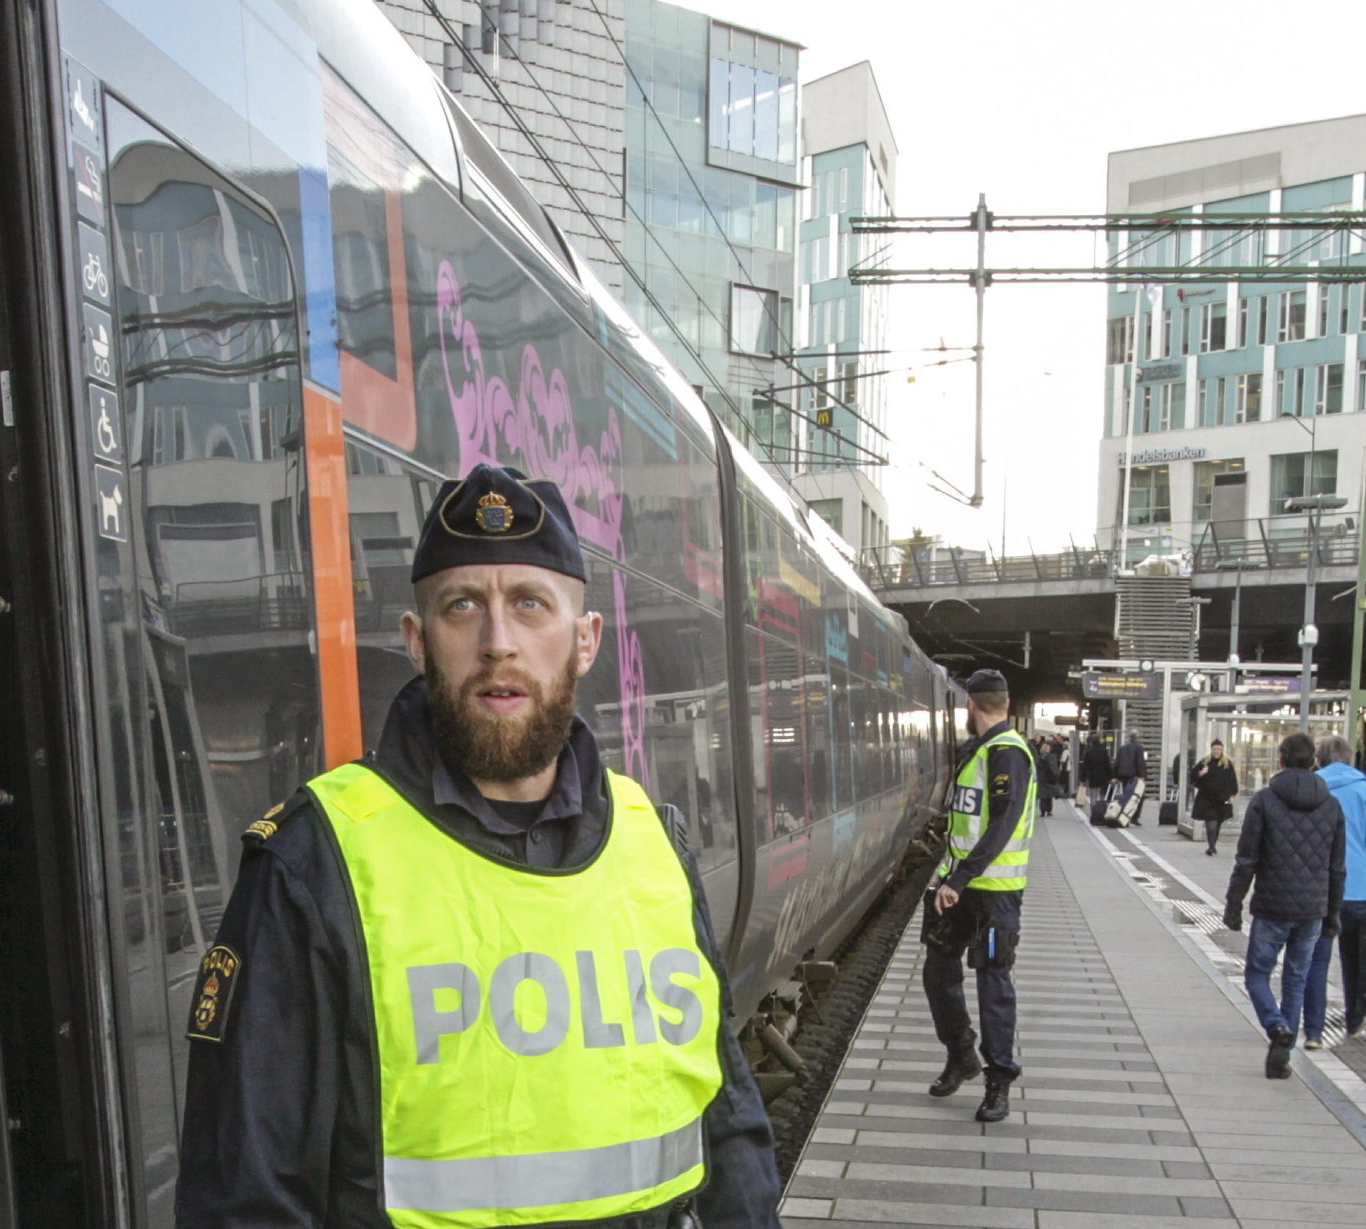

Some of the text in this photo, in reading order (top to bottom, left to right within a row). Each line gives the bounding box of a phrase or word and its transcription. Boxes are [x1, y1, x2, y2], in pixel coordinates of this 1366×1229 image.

[1118, 446, 1206, 465] Hndelsbanken
[953, 787, 976, 813] LIS
[203, 951, 235, 977] POLIS
[406, 948, 703, 1065] POLIS
